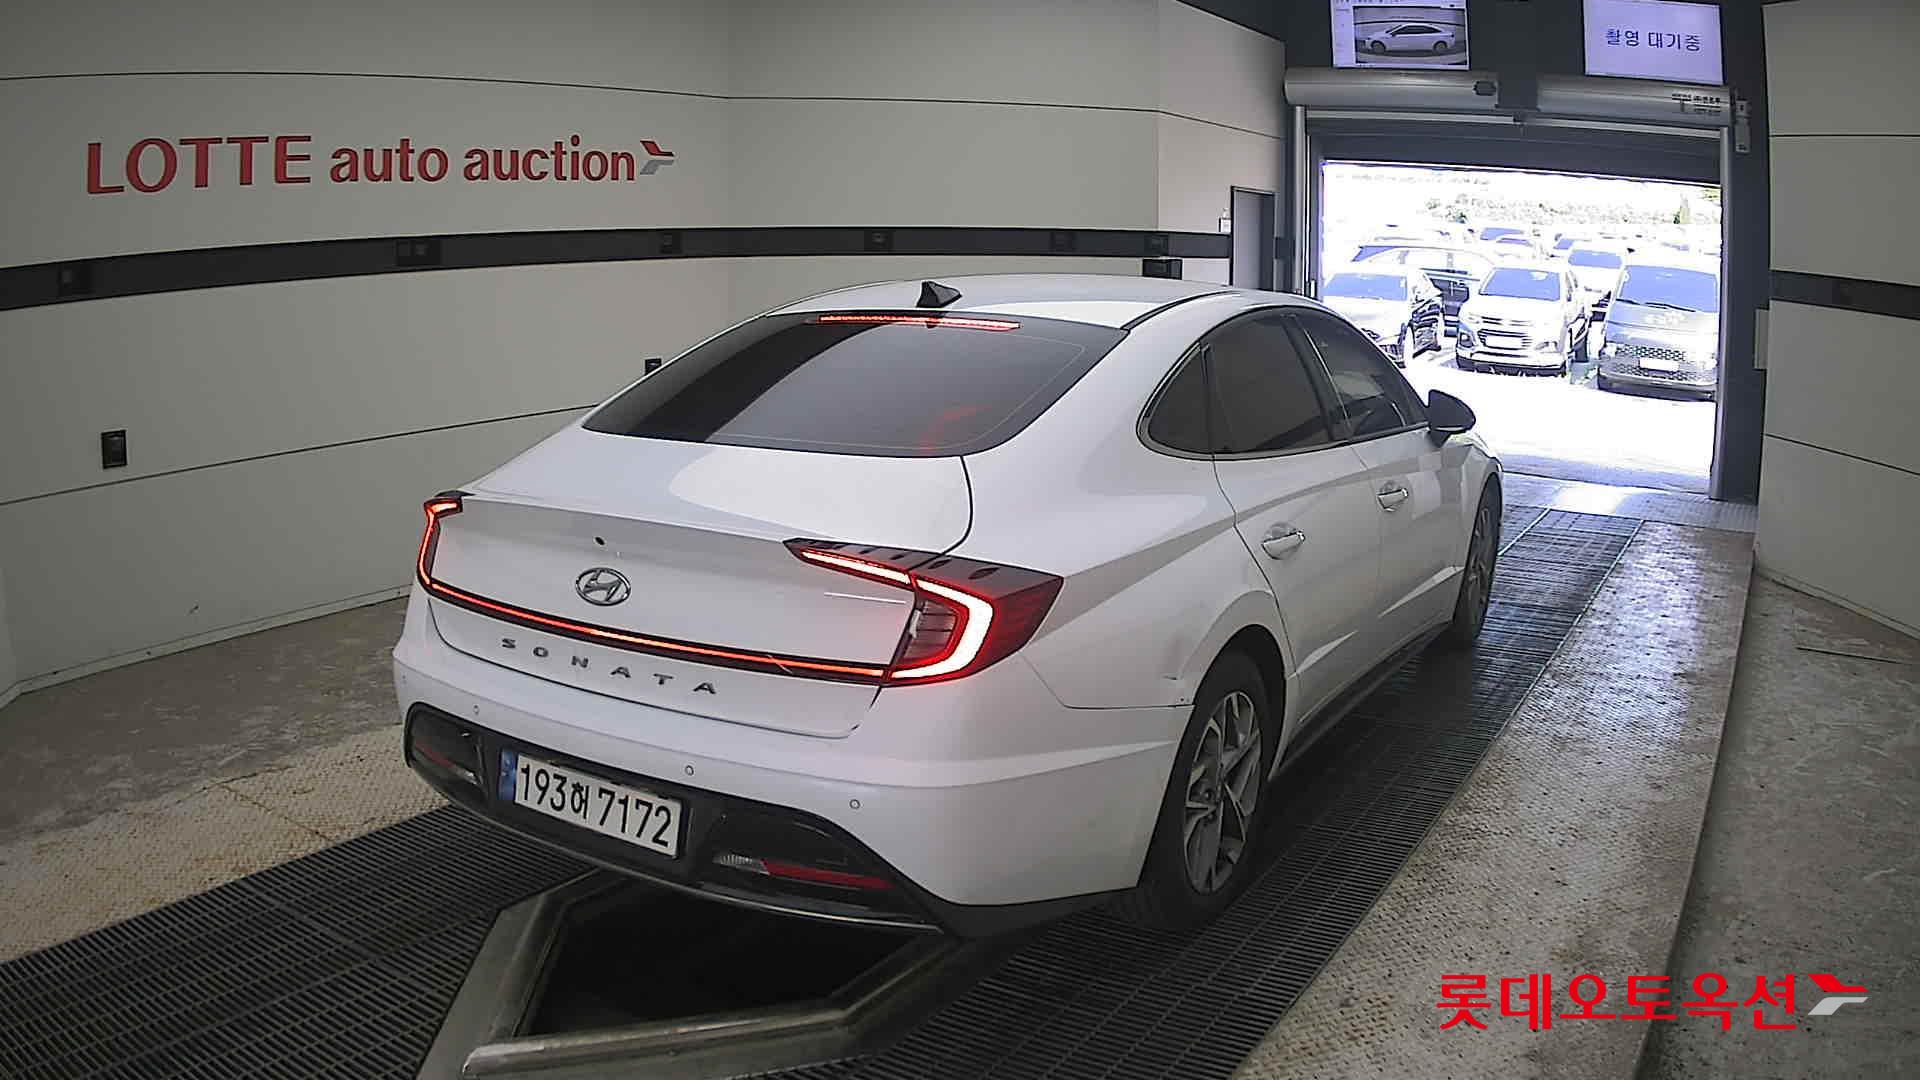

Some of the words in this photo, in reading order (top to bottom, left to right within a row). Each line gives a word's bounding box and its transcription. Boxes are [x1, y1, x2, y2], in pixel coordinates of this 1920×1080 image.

[1606, 28, 1640, 47] 촬영
[1647, 31, 1700, 52] 대기중
[86, 135, 312, 195] LOTTE
[330, 138, 449, 183] auto
[463, 135, 635, 182] auction
[501, 638, 717, 695] SONATA
[598, 786, 672, 848] 7172
